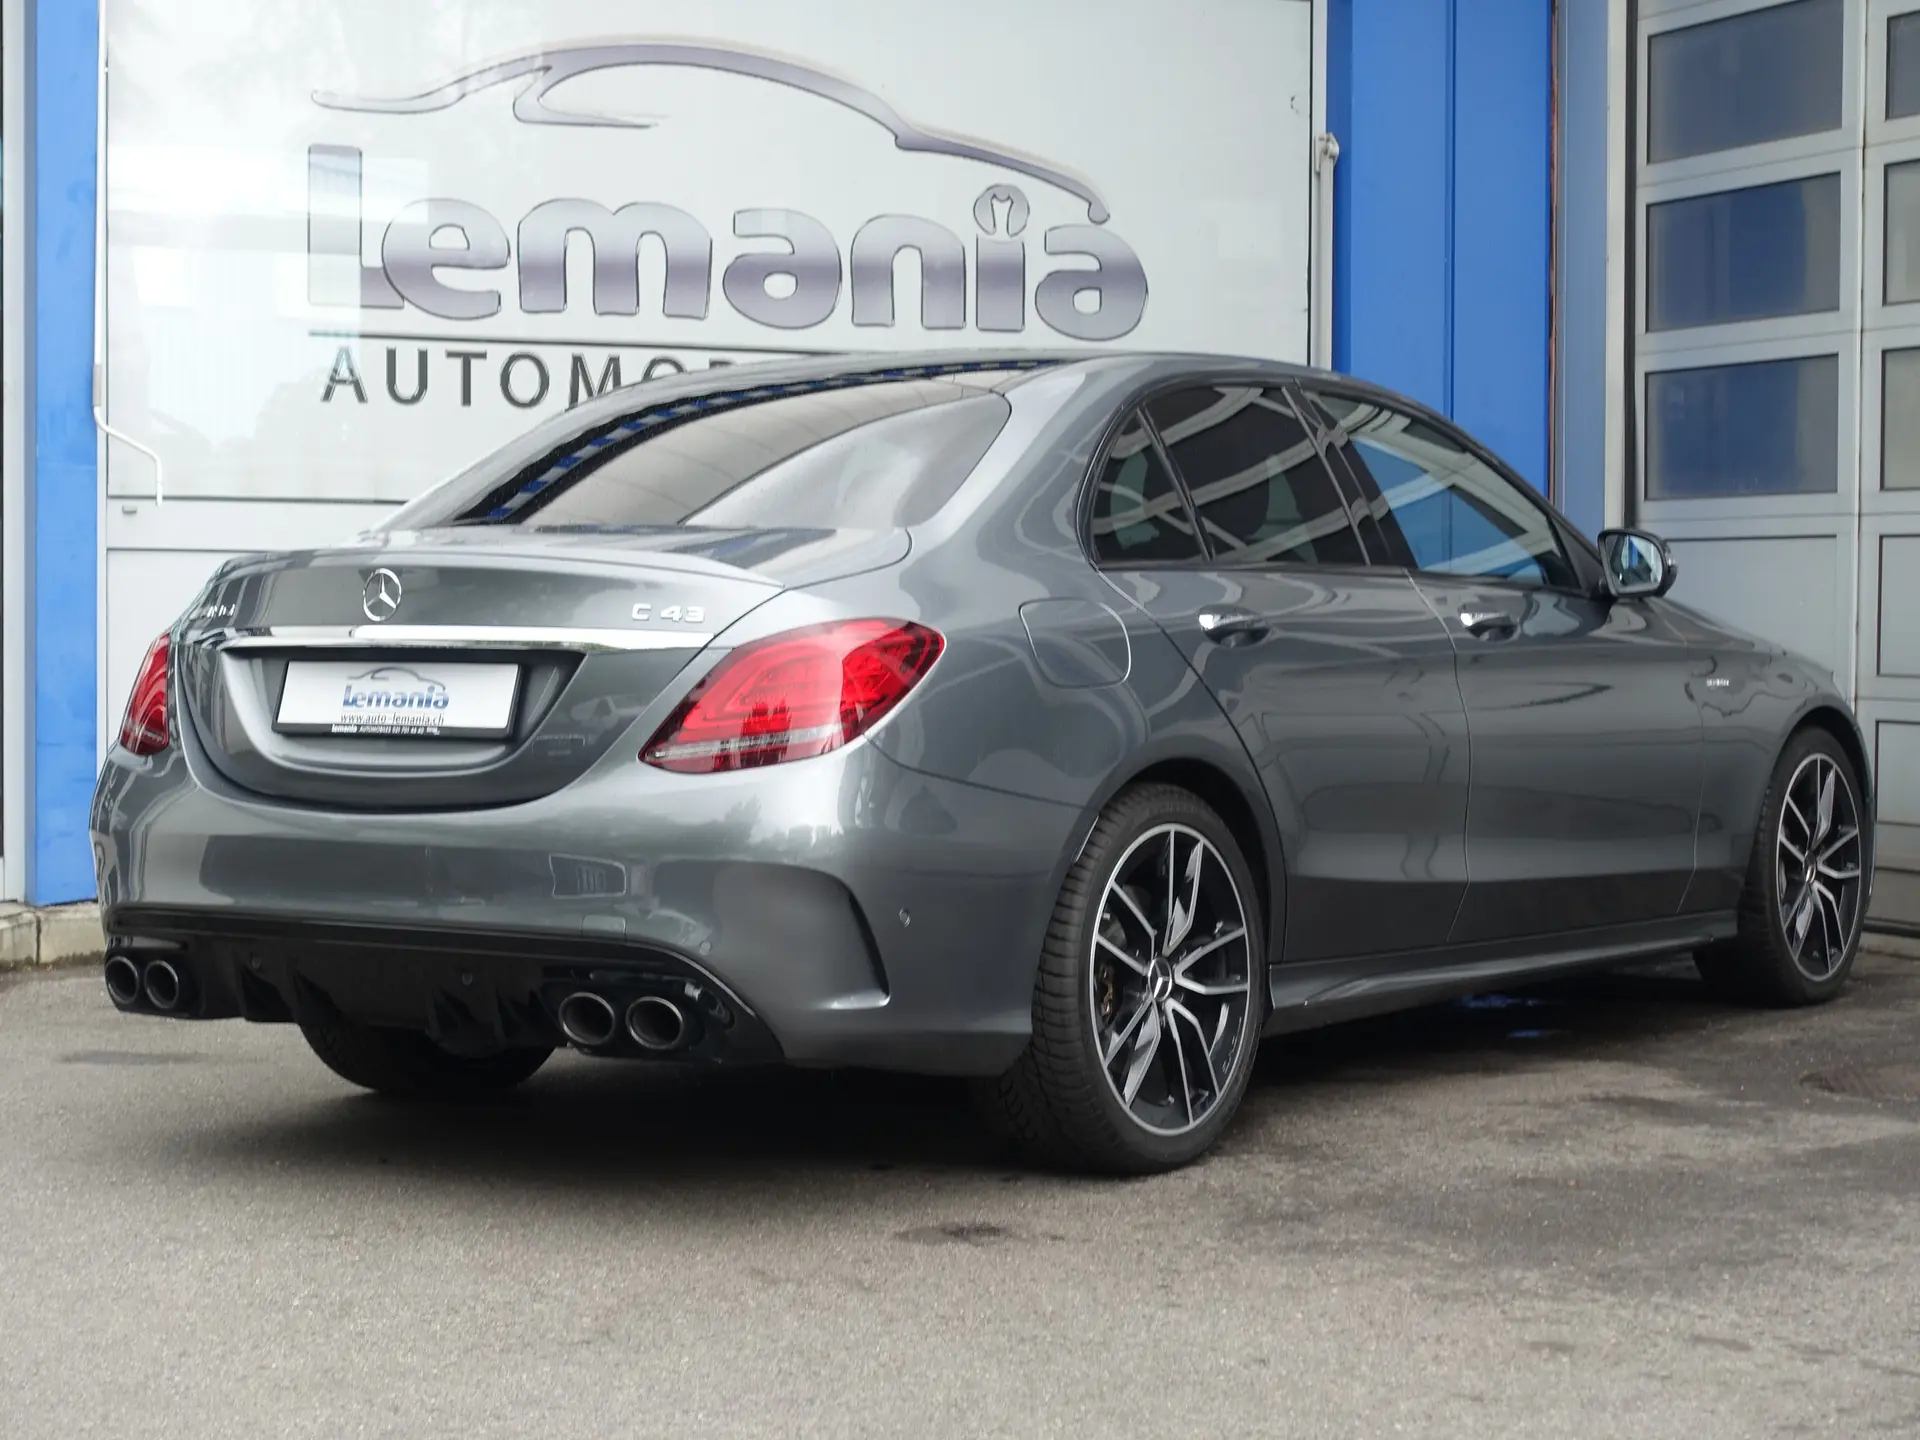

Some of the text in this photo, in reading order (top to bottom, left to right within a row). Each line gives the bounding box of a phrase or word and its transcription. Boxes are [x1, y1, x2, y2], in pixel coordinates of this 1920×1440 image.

[308, 143, 1149, 341] Lemania
[320, 346, 735, 410] AUTOM
[631, 603, 706, 624] C 43
[342, 684, 450, 710] Lemania
